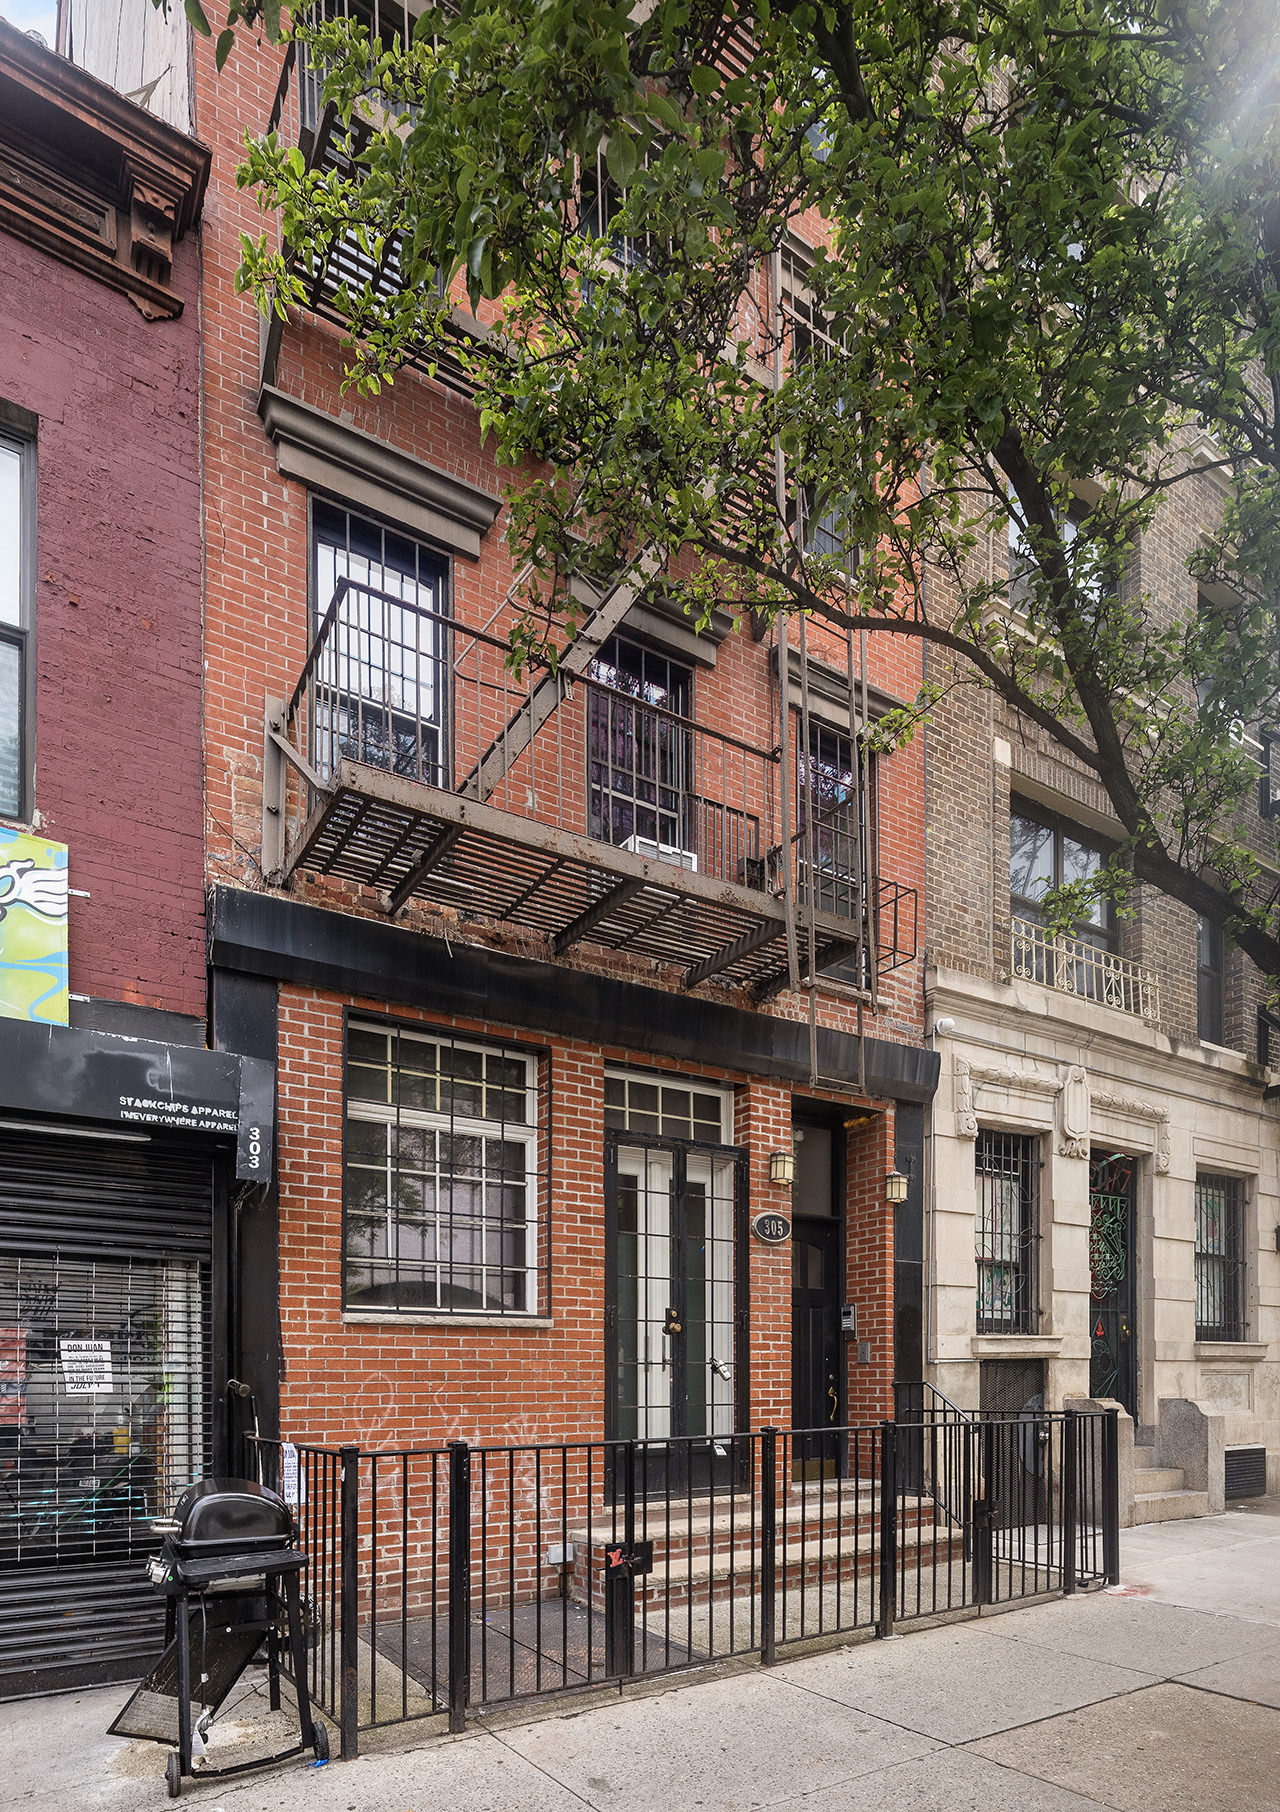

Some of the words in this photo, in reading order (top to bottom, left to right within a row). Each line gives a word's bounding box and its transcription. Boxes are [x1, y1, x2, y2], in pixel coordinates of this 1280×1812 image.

[190, 1105, 238, 1119] APPAREL
[248, 1127, 261, 1169] 303
[764, 1219, 784, 1236] 305
[67, 1344, 82, 1352] DON
